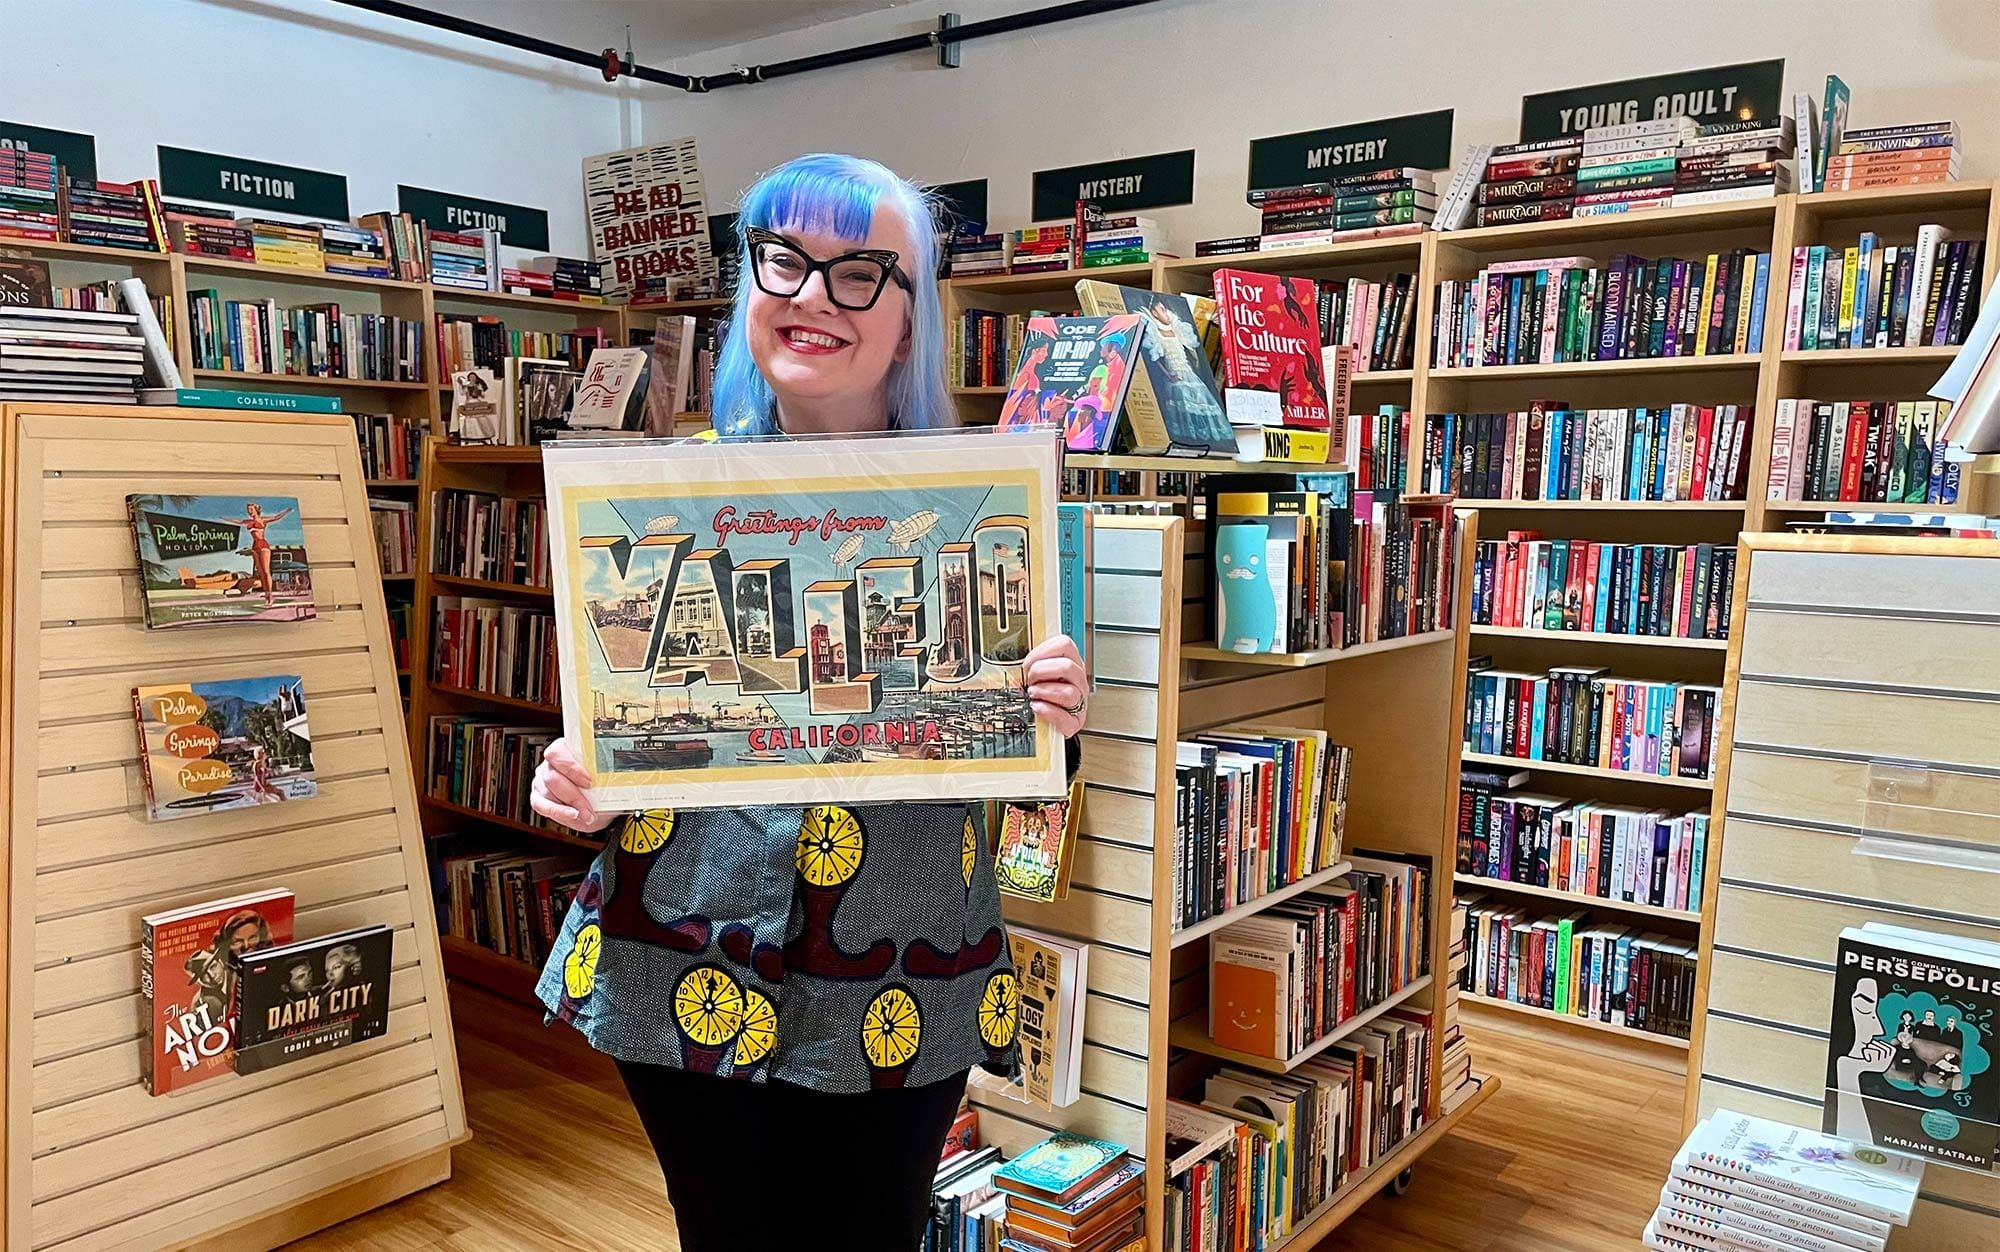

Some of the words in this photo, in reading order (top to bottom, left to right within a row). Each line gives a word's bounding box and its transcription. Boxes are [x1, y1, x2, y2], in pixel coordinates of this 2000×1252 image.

[1560, 100, 1639, 132] YOUNG
[1653, 86, 1738, 121] ADULT
[1741, 120, 1762, 131] KING
[1307, 138, 1388, 169] MYSTERY
[1515, 144, 1528, 152] THIS
[1547, 138, 1574, 148] AMERICA
[1869, 137, 1921, 150] UNWIND
[220, 170, 295, 200] FICTION
[1080, 174, 1144, 200] MYSTERY
[1344, 175, 1366, 185] SCATTER
[1494, 180, 1544, 198] MURTAGH
[613, 182, 683, 216] READ
[1593, 202, 1629, 216] STAMPED
[447, 206, 506, 232] FICTION
[1492, 205, 1541, 221] MURTAGH
[604, 212, 697, 251] BANNED
[614, 247, 697, 283] BOOKS
[1811, 252, 1821, 271] YOUR
[1935, 266, 1944, 281] HER
[1792, 270, 1803, 290] FAULT
[1810, 272, 1820, 293] FAULT
[1962, 269, 1972, 283] THE
[1230, 276, 1263, 302] For
[1490, 286, 1497, 295] SO
[1687, 287, 1700, 312] BLOOD
[1930, 282, 1942, 302] DARK
[1959, 285, 1969, 301] WAY
[1601, 272, 1622, 347] BLOODMARKED
[1667, 287, 1680, 331] RUINSONG
[1741, 285, 1750, 319] GILDED
[1954, 302, 1965, 321] BACK
[1233, 303, 1266, 327] the
[1685, 312, 1697, 334] SCION
[1925, 303, 1938, 327] WINGS
[1062, 326, 1097, 334] ODE
[1236, 326, 1307, 355] Culture
[1737, 319, 1745, 342] ONES
[1051, 340, 1096, 359] HIP-HOP
[1336, 358, 1348, 404] FREEDOM'S
[236, 396, 297, 408] COASTLINES
[1334, 407, 1345, 448] DOMINION
[1774, 426, 1791, 447] OUT
[1817, 417, 1828, 446] BETWEEN
[1851, 420, 1863, 457] FOUNTAINS
[1264, 431, 1291, 459] KING
[1832, 436, 1843, 458] SALT
[1864, 425, 1880, 467] TWEAK
[1572, 454, 1580, 468] BIG
[1648, 448, 1656, 484] OUTSIDERS
[1682, 445, 1692, 482] RAYBEARER
[1815, 447, 1825, 470] SHADES
[1769, 455, 1788, 488] SALEM
[1828, 465, 1839, 483] SEA
[1846, 463, 1858, 490] SILENCE
[1812, 477, 1822, 493] GRAY
[154, 524, 189, 545] Palm
[191, 524, 235, 548] Springs
[712, 505, 820, 546] Greetings
[820, 508, 888, 542] from
[1484, 568, 1494, 585] DEFY
[1711, 565, 1721, 593] SCATTER
[1482, 590, 1492, 612] NIGHT
[579, 514, 1034, 715] VALLEJO
[160, 698, 202, 723] Palm
[748, 721, 942, 752] CALIFORNIA
[1614, 712, 1623, 739] MOXIE
[1625, 714, 1633, 735] MOTH
[1661, 710, 1674, 763] LAKELORE
[169, 734, 218, 757] Springs
[181, 768, 232, 788] Paradise
[1188, 777, 1196, 818] BLACK
[1460, 793, 1473, 833] Gilded
[1473, 795, 1488, 838] Cursed
[1187, 819, 1195, 868] FUTURES
[1488, 813, 1502, 865] ARCHENEMIES
[1522, 825, 1532, 860] midnight
[1638, 847, 1648, 877] loveless
[701, 970, 709, 979] 12
[1591, 952, 1601, 984] STAMPED
[1843, 951, 2000, 995] PERSEPOLIS
[1891, 956, 1908, 966] THE
[1911, 960, 1957, 975] COMPLETE
[679, 987, 688, 995] 10
[689, 975, 694, 983] 11
[718, 977, 723, 986] 1
[730, 987, 736, 995] 2
[164, 1003, 188, 1024] The
[268, 994, 320, 1032] DARK
[328, 982, 372, 1015] CITY
[679, 1003, 685, 1012] 9
[733, 1003, 739, 1012] 3
[1020, 1003, 1044, 1028] LOGY
[164, 1003, 212, 1054] ART
[684, 1017, 691, 1026] 8
[696, 1028, 702, 1037] 7
[724, 1029, 730, 1037] 5
[730, 1017, 736, 1025] 4
[284, 1041, 311, 1054] EDDIE
[315, 1029, 349, 1045] MULLER
[711, 1030, 717, 1040] 6
[1884, 1135, 1935, 1153] MARJANE
[1937, 1147, 1985, 1165] SATRAPI
[1738, 1186, 1759, 1197] willa
[1760, 1191, 1785, 1204] cather
[1792, 1202, 1805, 1211] my
[1755, 1175, 1775, 1185] willa
[1777, 1180, 1801, 1191] cather
[1809, 1190, 1822, 1200] my
[1734, 1202, 1755, 1213] willa
[1756, 1207, 1780, 1220] cather
[1788, 1217, 1801, 1227] my
[1726, 1215, 1746, 1226] willa
[1748, 1221, 1773, 1234] cather
[1780, 1231, 1792, 1240] my
[1723, 1231, 1744, 1242] willa
[1745, 1236, 1770, 1249] cather
